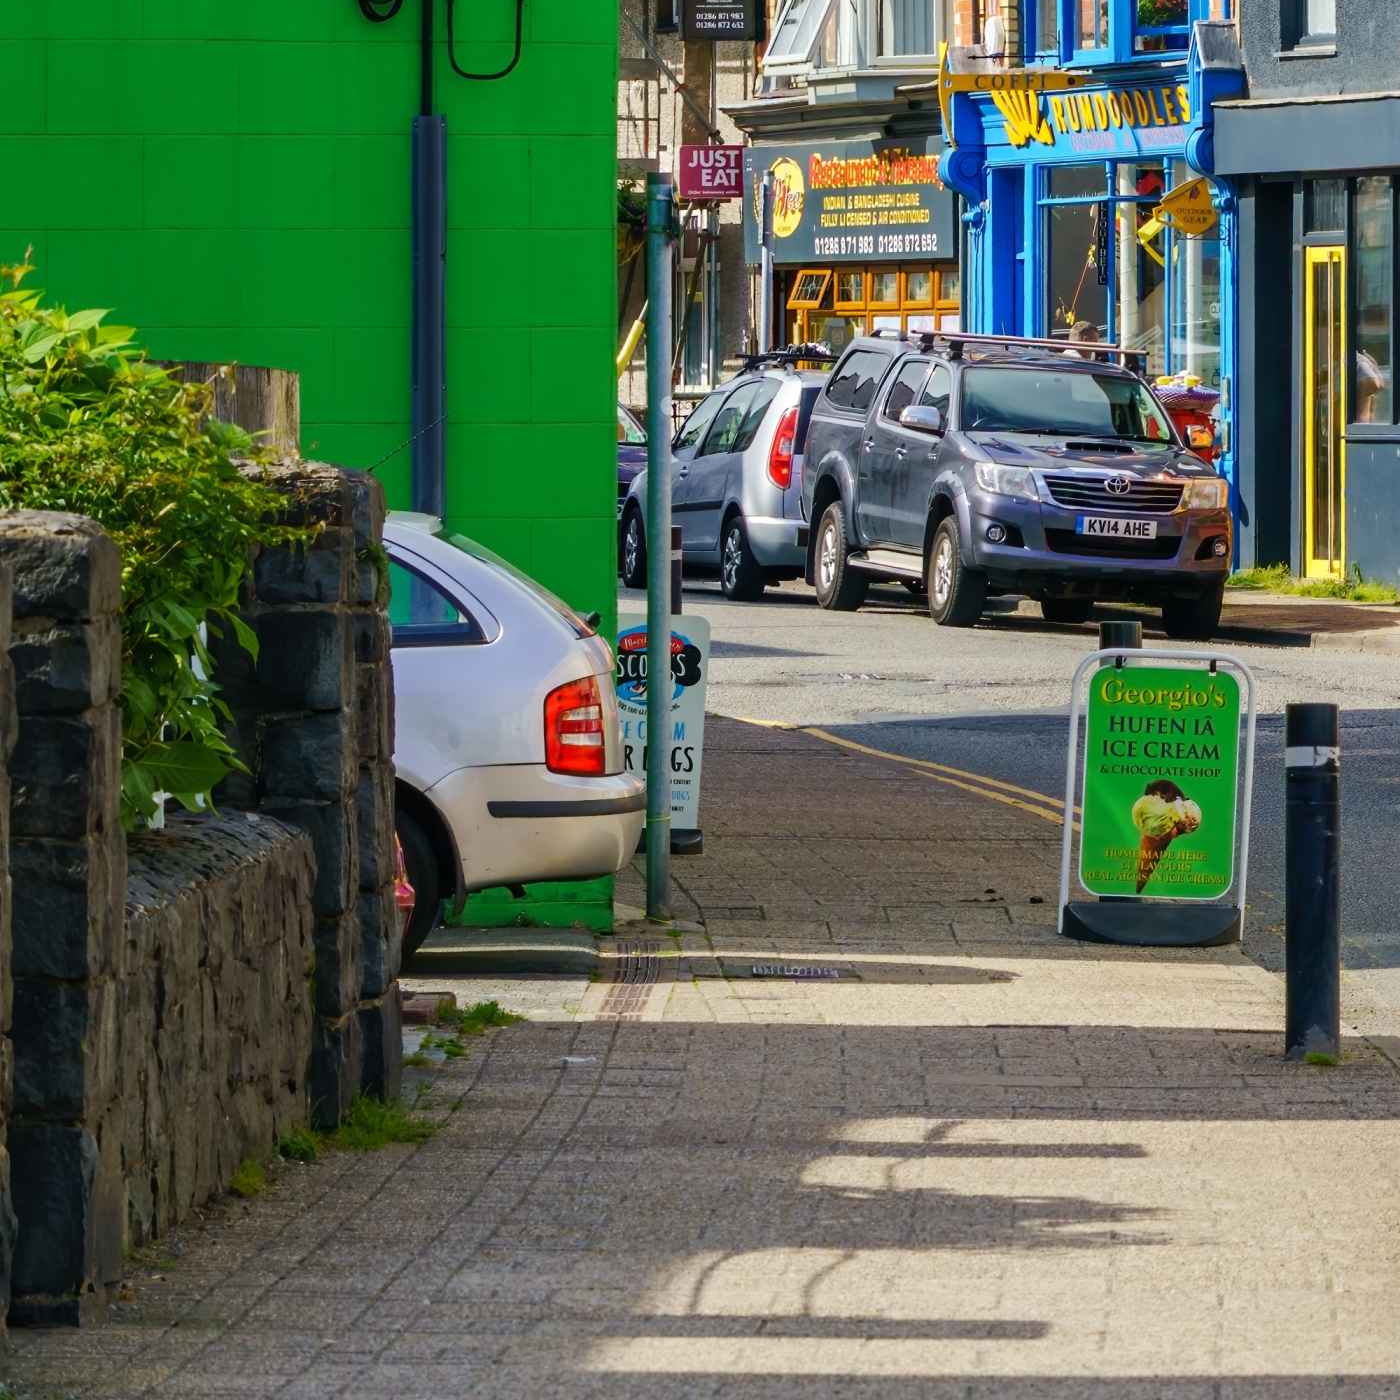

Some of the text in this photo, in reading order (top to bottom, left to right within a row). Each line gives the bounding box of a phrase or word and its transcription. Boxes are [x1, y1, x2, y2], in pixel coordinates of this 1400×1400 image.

[974, 74, 1047, 90] COFFI
[688, 150, 740, 168] JUST
[701, 168, 740, 187] EAT
[823, 192, 920, 210] INDIAN & BANGLADESHI CUISINE
[820, 213, 838, 227] FULLY
[872, 211, 878, 225] &
[878, 211, 888, 224] AIR
[889, 208, 930, 224] CONDITIONED
[1184, 216, 1208, 224] GEAR
[814, 236, 839, 255] 01286
[858, 235, 874, 254] 983
[878, 234, 904, 253] 01286
[905, 233, 920, 252] 872
[921, 233, 938, 251] 652
[1087, 519, 1150, 536] KV14 AHE
[1101, 679, 1226, 711] Georgio's
[1109, 715, 1215, 736] HUFEN IÂ
[1103, 740, 1220, 760] ICE CREAM
[1100, 764, 1222, 777] & CHOCOLATE SHOP
